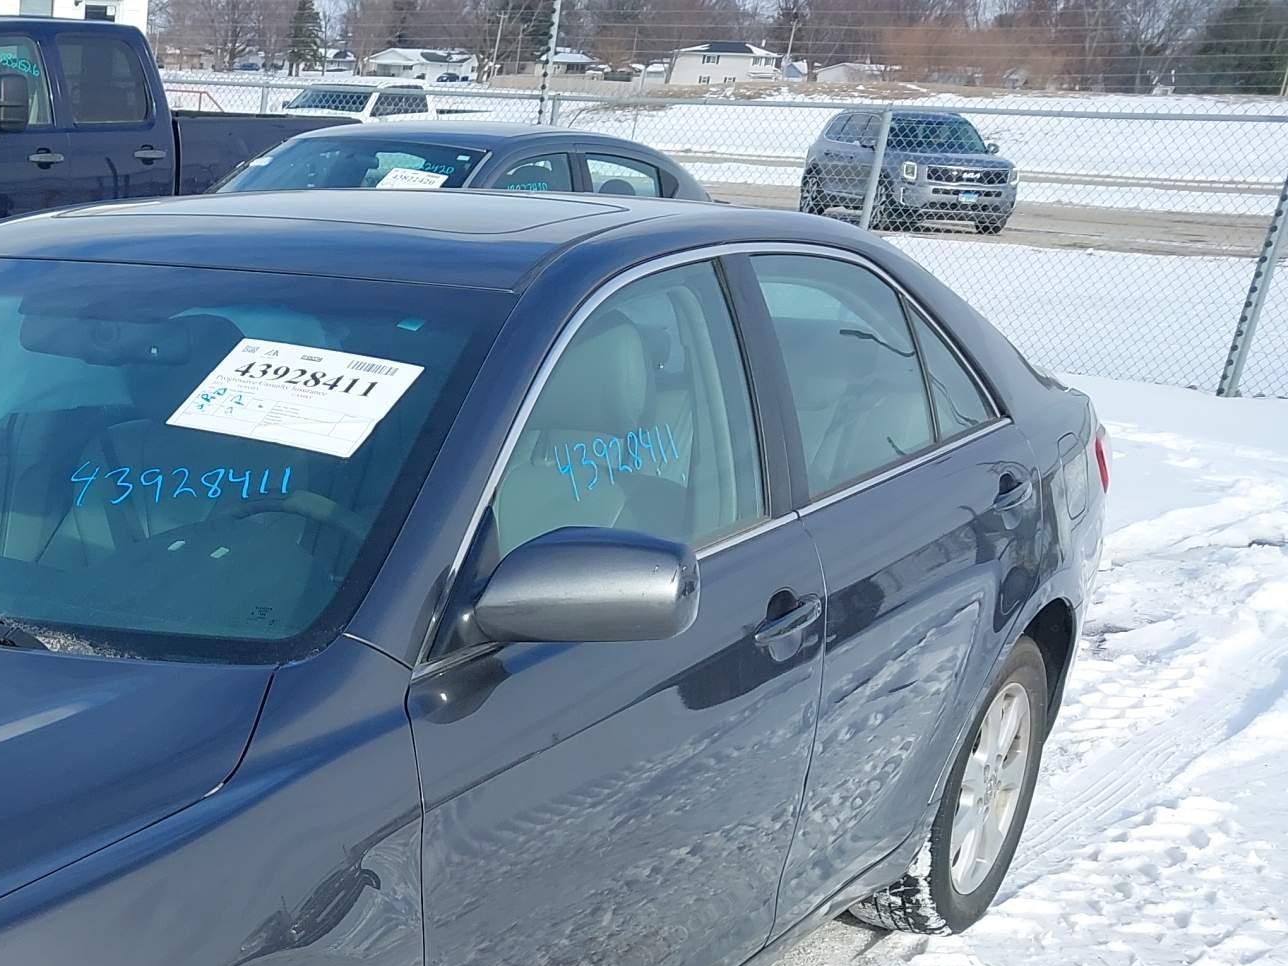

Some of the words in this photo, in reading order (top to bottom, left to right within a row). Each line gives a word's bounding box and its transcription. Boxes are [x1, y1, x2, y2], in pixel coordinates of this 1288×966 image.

[234, 361, 379, 397] 43928411
[70, 460, 291, 506] 43928411
[554, 423, 679, 502] 43928411
